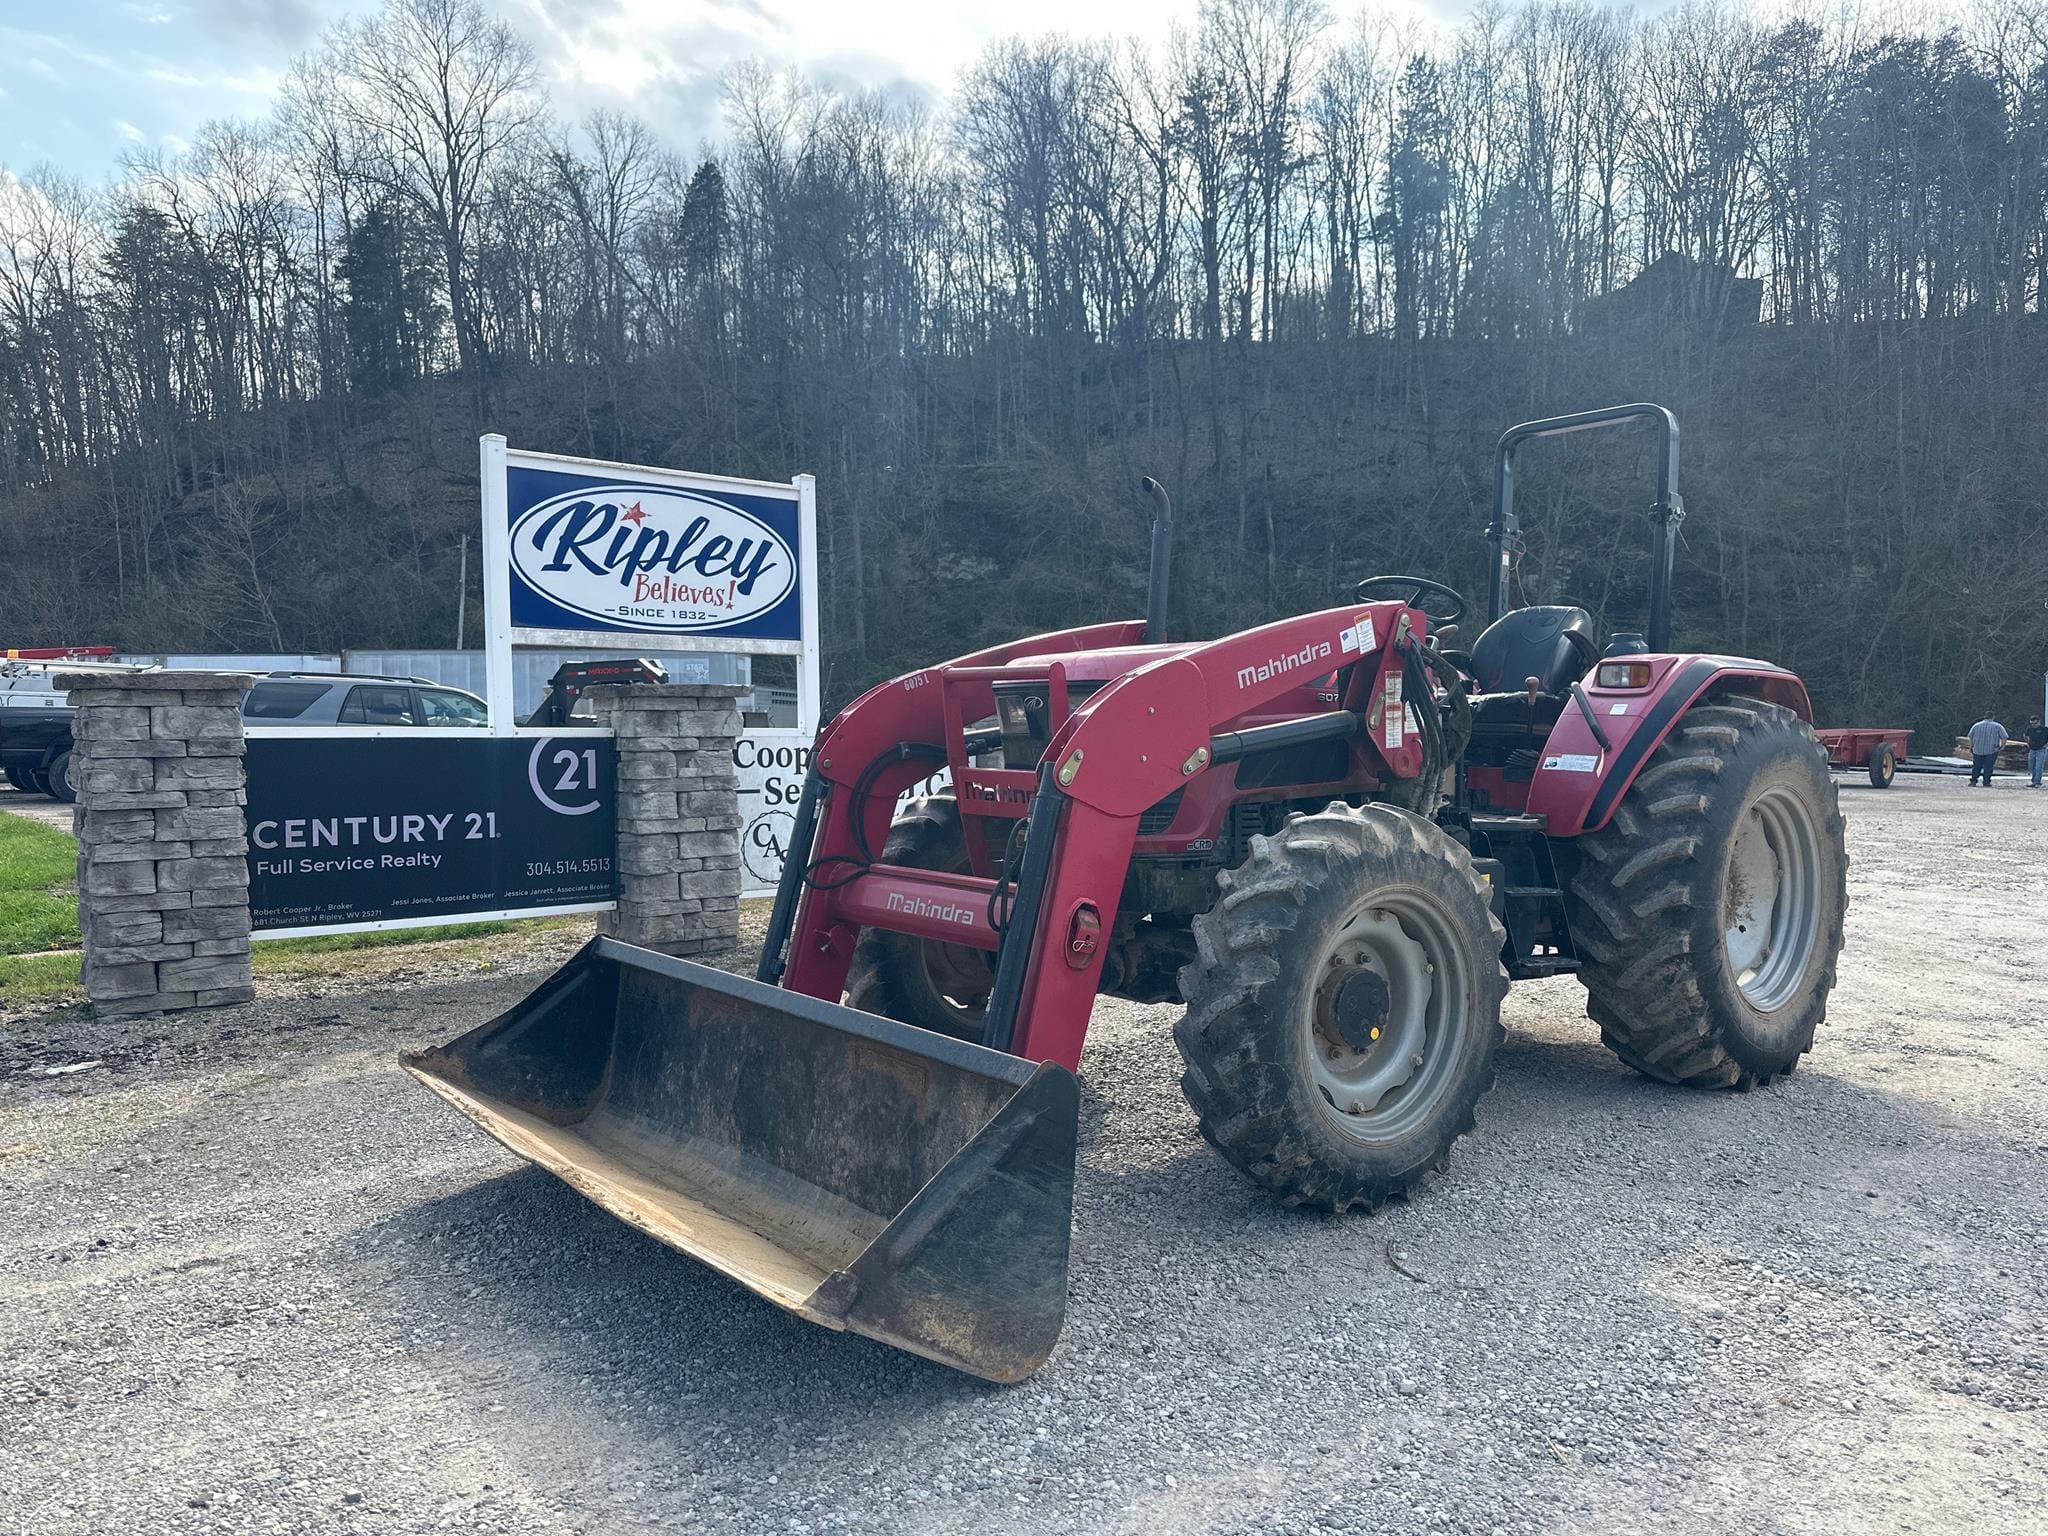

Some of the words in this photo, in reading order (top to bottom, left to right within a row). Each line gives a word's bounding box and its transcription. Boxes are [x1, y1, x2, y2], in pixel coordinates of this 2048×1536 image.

[532, 500, 777, 596] Ripley
[633, 572, 737, 610] Believes!
[618, 605, 665, 619] SINCE
[671, 609, 708, 621] 1832
[1237, 641, 1332, 689] Mahindra
[904, 675, 924, 691] 6075
[1317, 692, 1339, 702] 607
[732, 739, 810, 776] Coop
[765, 776, 804, 806] Se
[252, 813, 454, 850] CENTURY
[256, 860, 293, 876] Full
[299, 856, 375, 874] Service
[380, 852, 443, 870] Realty
[526, 857, 611, 877] 304.514.5513
[391, 898, 410, 907] Jessi
[411, 896, 434, 905] Jones,
[435, 893, 471, 903] Associate
[471, 891, 496, 901] Broker
[503, 889, 529, 898] Jessica
[529, 887, 555, 896] Jarrett,
[556, 885, 589, 894] Associate
[589, 882, 611, 891] Broker
[253, 908, 281, 917] Robert
[283, 906, 311, 916] Cooper
[328, 902, 354, 911] Broker
[254, 918, 268, 927] 681
[269, 915, 298, 926] Church
[298, 915, 309, 923] St
[311, 914, 318, 922] N
[319, 912, 346, 923] Ripley,
[346, 911, 361, 919] WV
[361, 909, 383, 918] 25271
[886, 892, 975, 926] Mahindra
